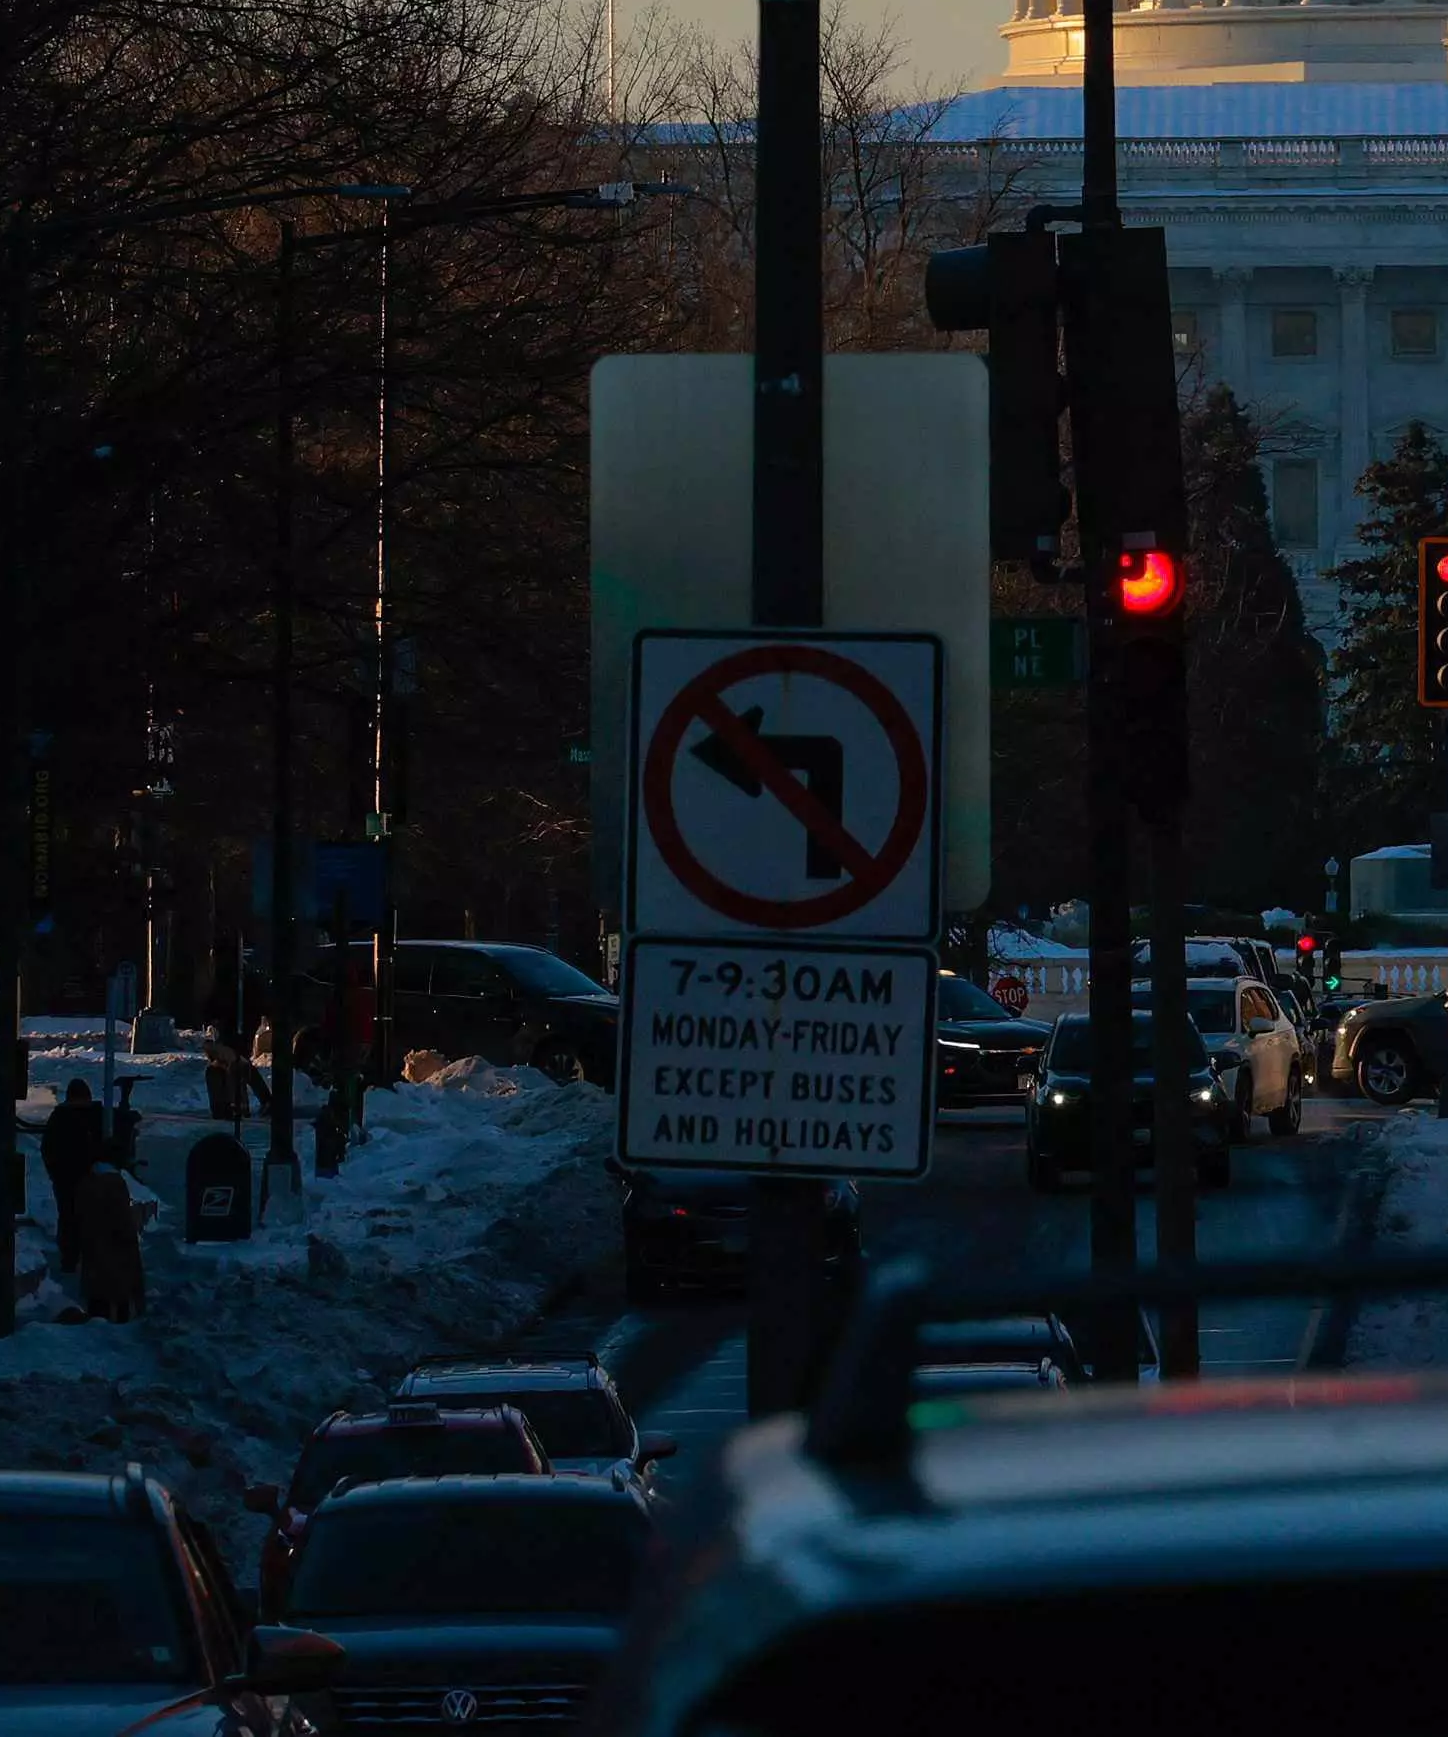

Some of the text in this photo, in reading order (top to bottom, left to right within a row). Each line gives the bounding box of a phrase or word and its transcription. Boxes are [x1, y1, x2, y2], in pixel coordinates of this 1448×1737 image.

[1014, 628, 1043, 649] PL
[1014, 655, 1044, 678] NE
[669, 959, 893, 1004] 7-9:30AM
[994, 986, 1025, 1005] STOP
[652, 1011, 904, 1056] MONDAY-FRIDAY
[654, 1066, 896, 1104] EXCEPT BUSES
[652, 1113, 895, 1154] AND HOLIDAYS
